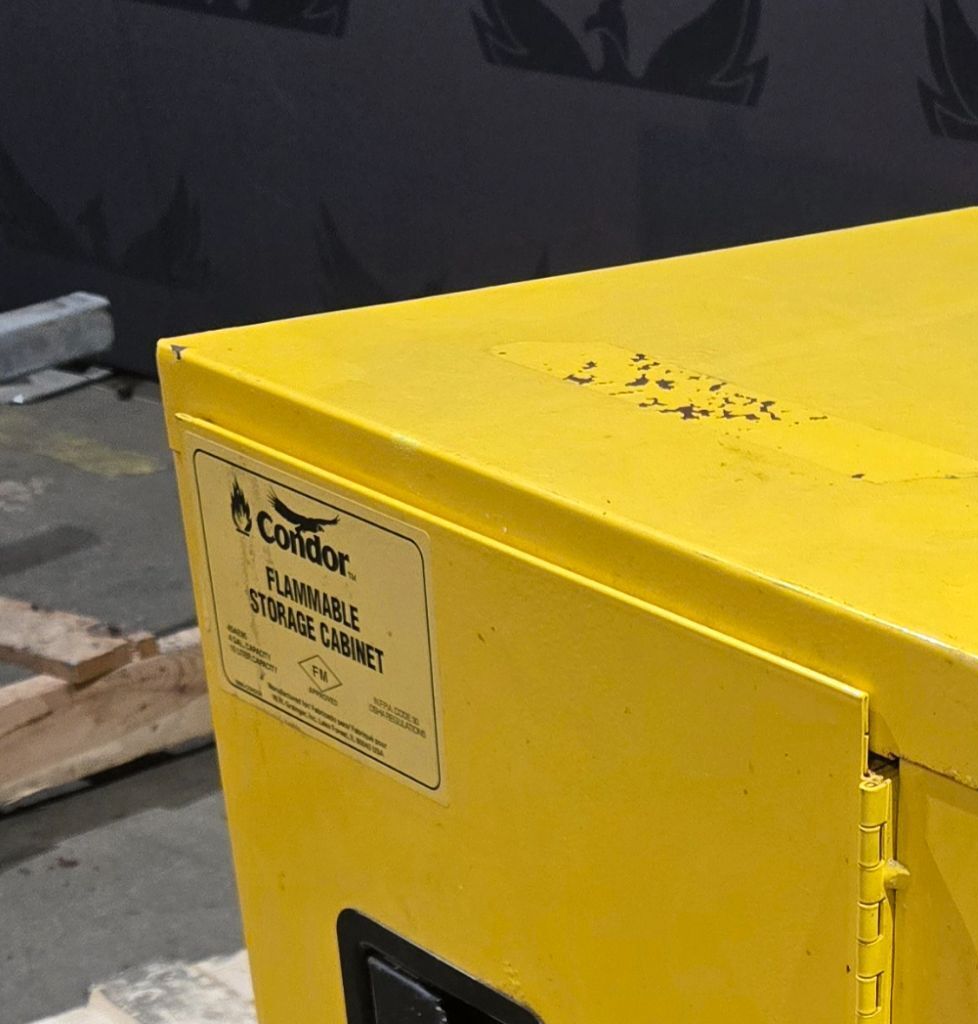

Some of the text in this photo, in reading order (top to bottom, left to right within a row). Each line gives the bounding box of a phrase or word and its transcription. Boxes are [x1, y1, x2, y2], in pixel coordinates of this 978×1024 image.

[257, 511, 350, 577] Condor
[250, 588, 385, 674] STORAGE CABINET
[265, 566, 361, 632] FLAMMABLE
[312, 665, 328, 683] FM
